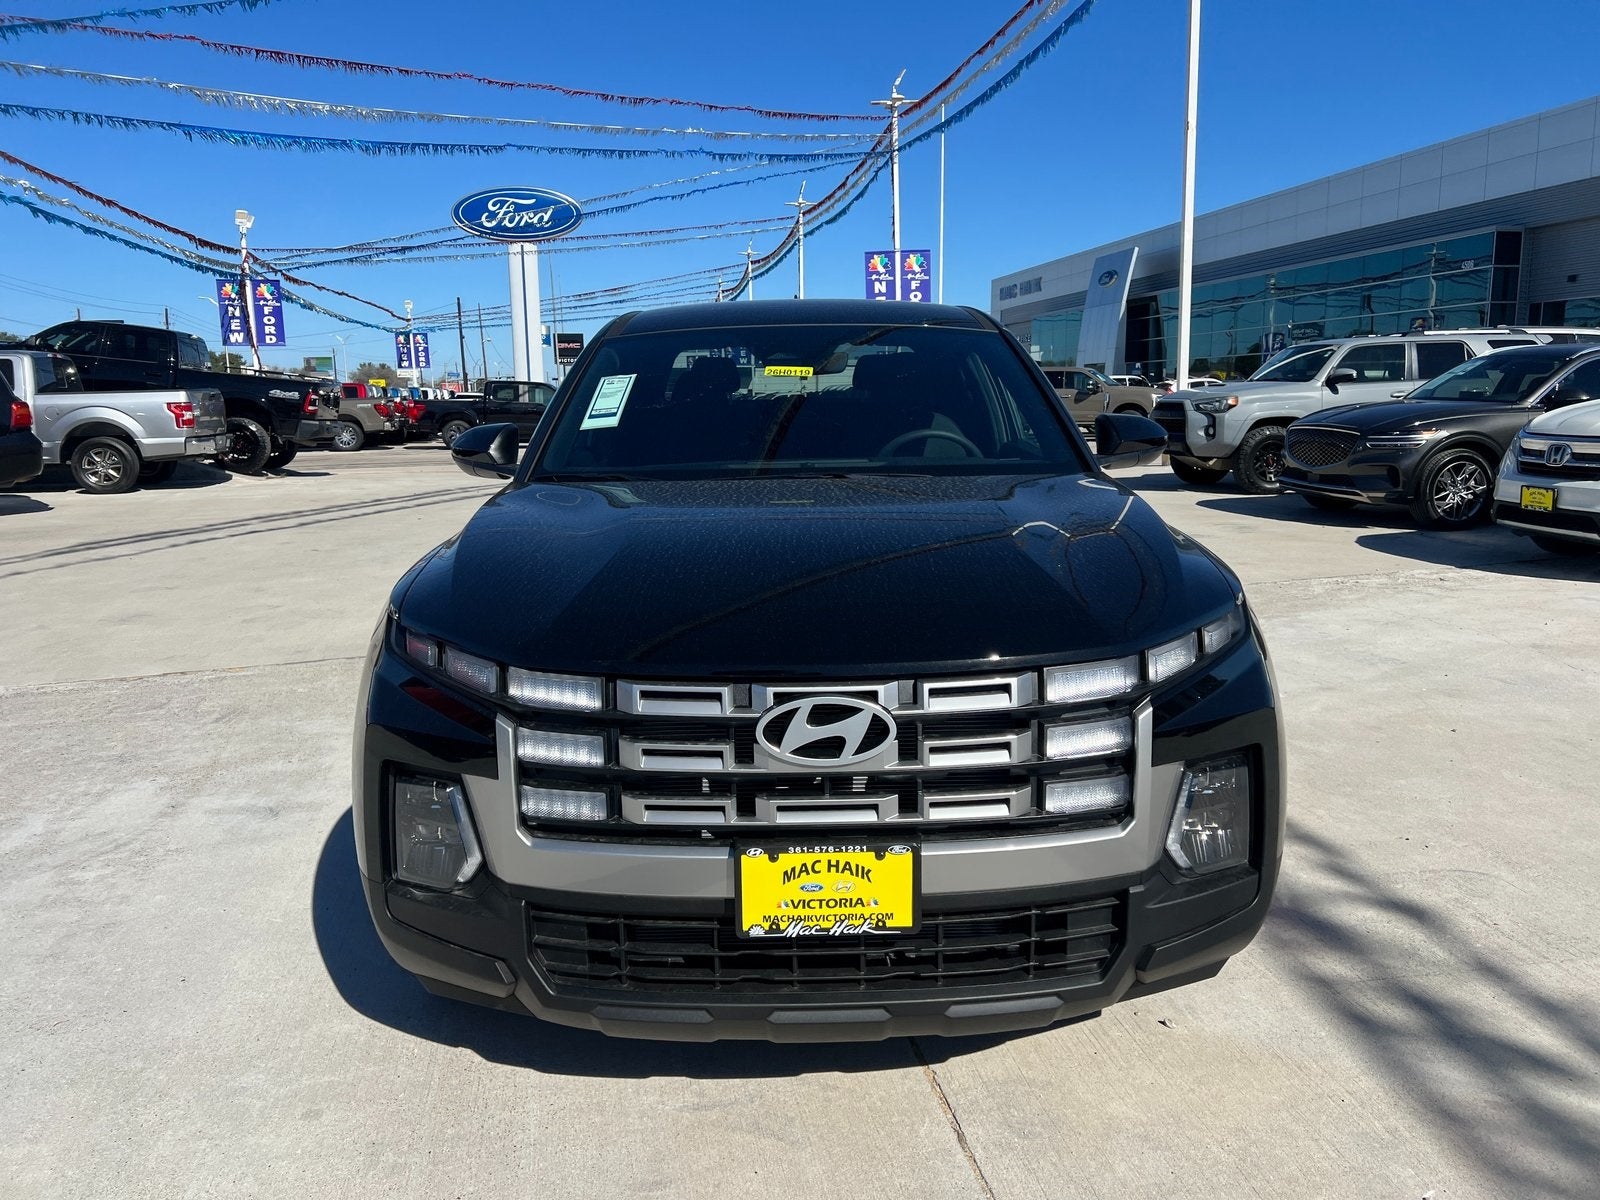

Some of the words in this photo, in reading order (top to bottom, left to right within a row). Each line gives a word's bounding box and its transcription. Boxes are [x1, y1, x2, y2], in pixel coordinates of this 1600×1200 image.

[481, 197, 555, 228] Ford
[227, 306, 244, 343] NEW
[263, 306, 277, 344] FORD
[766, 368, 811, 377] 26H0119
[788, 845, 868, 854] 361-576-1221
[782, 859, 822, 885] MAC
[827, 859, 873, 884] HAIK
[803, 883, 821, 893] Ford
[790, 897, 866, 910] VICTORIA
[762, 912, 894, 923] MACHAIKVICTORIA.COM
[784, 919, 828, 938] Mac
[828, 918, 876, 937] Haik
